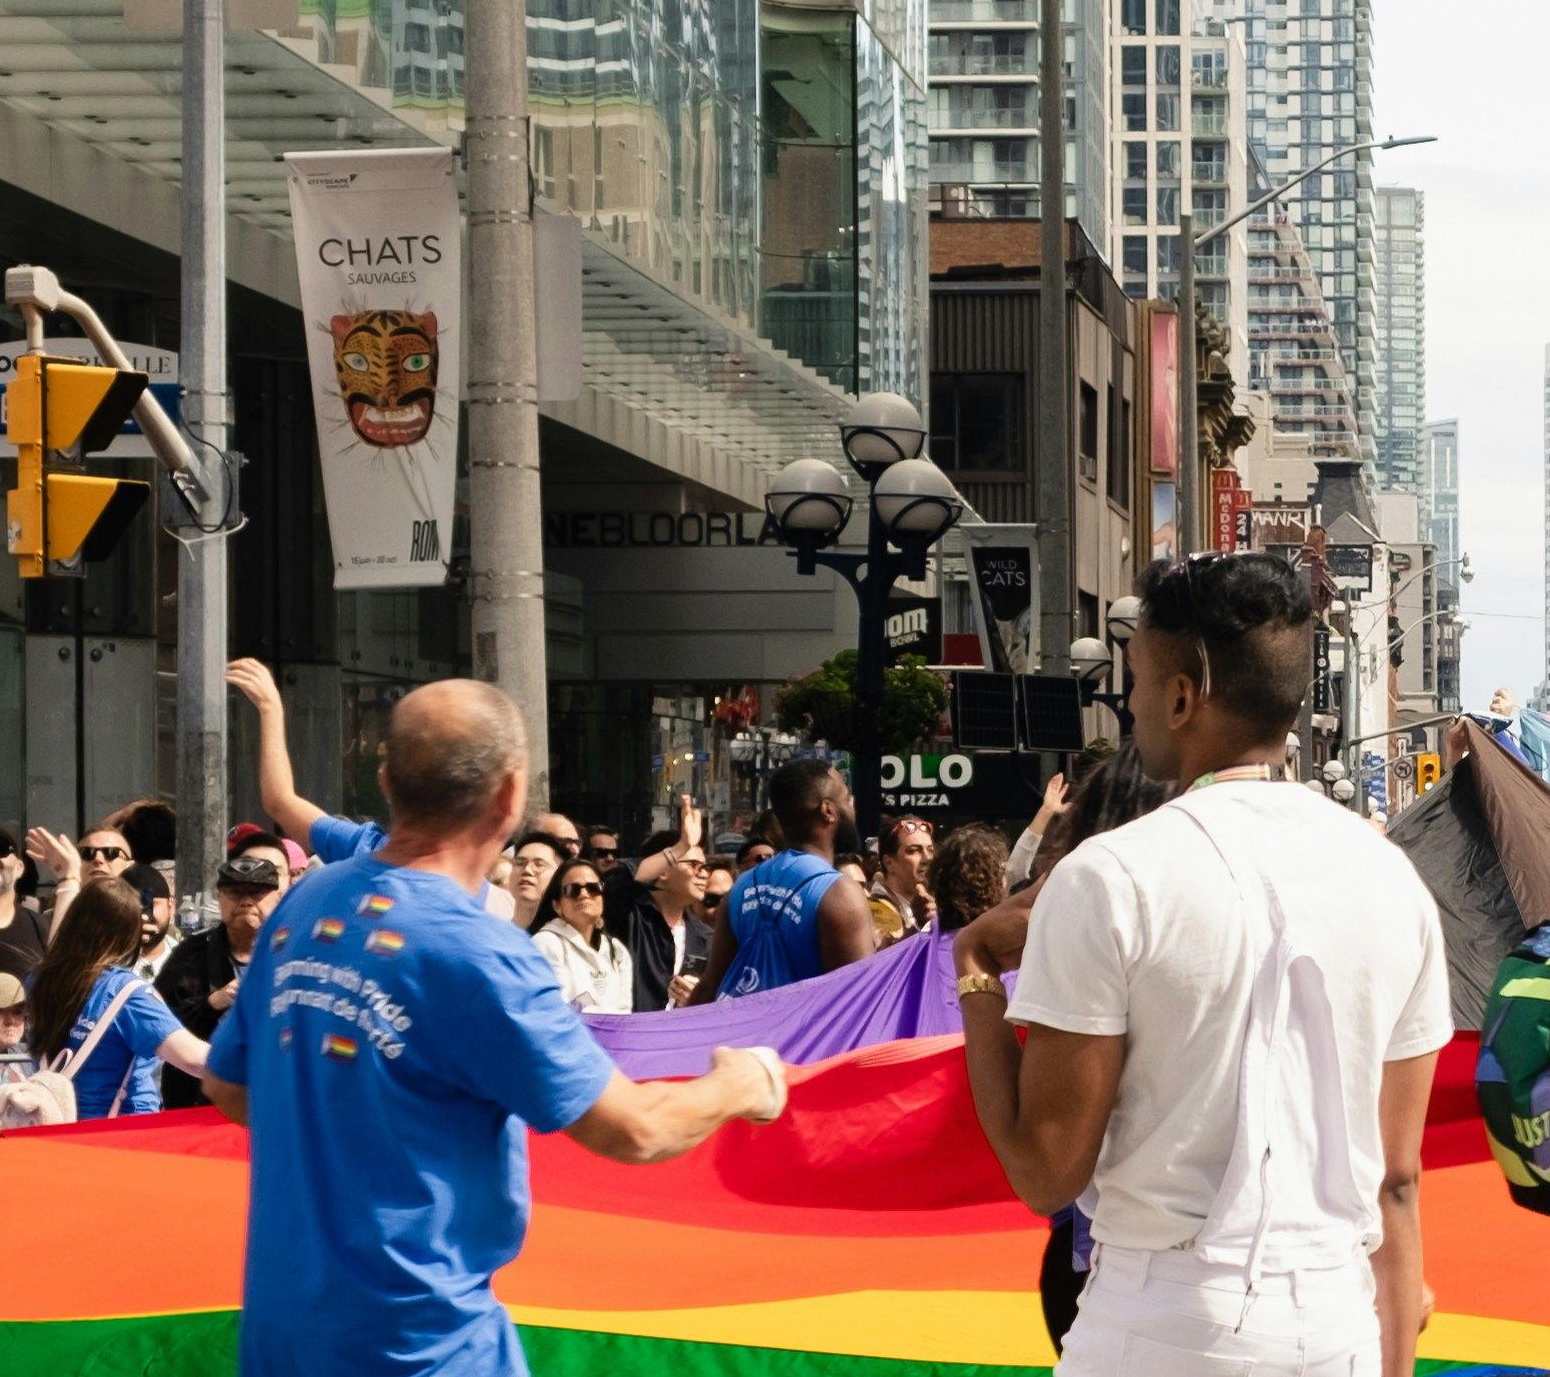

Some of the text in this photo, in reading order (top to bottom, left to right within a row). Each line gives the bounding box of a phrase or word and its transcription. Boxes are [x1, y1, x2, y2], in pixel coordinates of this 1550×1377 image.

[319, 235, 441, 267] CHATS
[348, 272, 416, 285] SAUVAGES
[410, 519, 439, 562] ROM
[985, 559, 1017, 570] WILD
[982, 571, 1026, 587] CATS
[900, 792, 950, 806] PIZZA
[359, 978, 413, 1032] Pride
